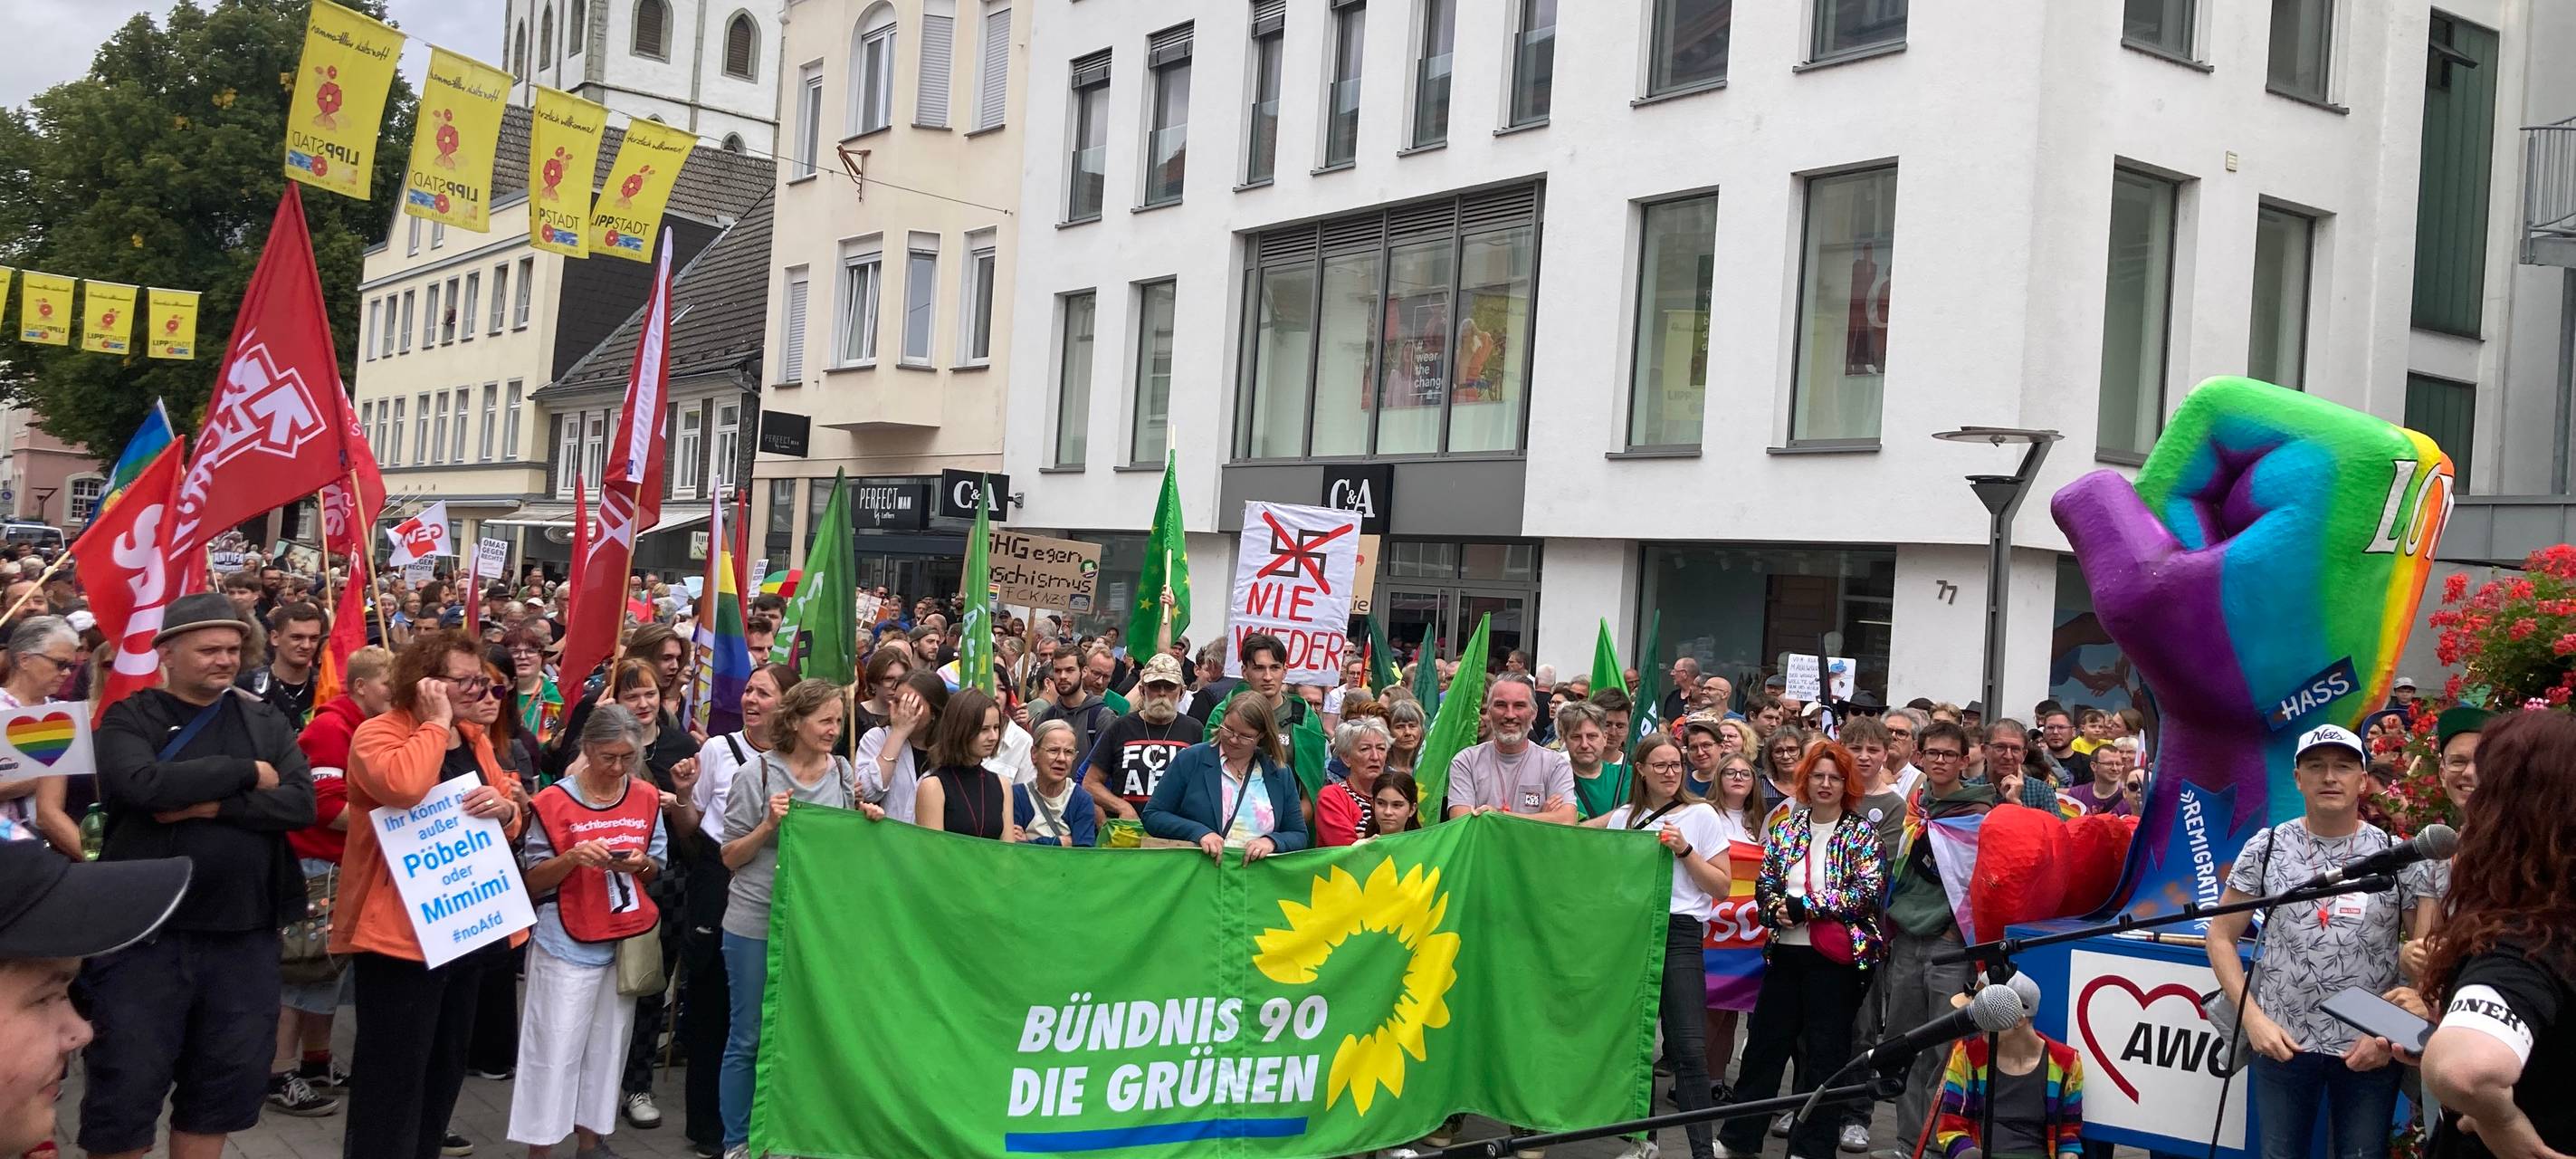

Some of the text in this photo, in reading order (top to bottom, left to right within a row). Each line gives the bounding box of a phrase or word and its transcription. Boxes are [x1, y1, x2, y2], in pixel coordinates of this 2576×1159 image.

[1415, 363, 1430, 376] the
[1416, 352, 1438, 362] wear
[1414, 376, 1441, 388] chang
[859, 487, 899, 510] PERFECT
[1330, 478, 1376, 518] C&A
[482, 539, 506, 550] OMAS
[482, 547, 504, 557] GEGEN
[481, 553, 503, 562] RECHTS
[1245, 581, 1317, 622] NIE
[1935, 580, 1958, 605] 77
[2281, 672, 2350, 721] HASS
[2310, 728, 2347, 744] Nets
[1123, 770, 1165, 796] AF
[384, 796, 453, 832] Ihr könnt
[418, 815, 460, 840] außer
[403, 829, 493, 879] Pöbeln
[442, 865, 473, 886] oder
[420, 869, 511, 925] Mimimi
[452, 910, 504, 944] #noAfd
[1016, 991, 1329, 1053] BÜNDNIS 90
[1007, 1045, 1320, 1117] DIE GRÜNEN
